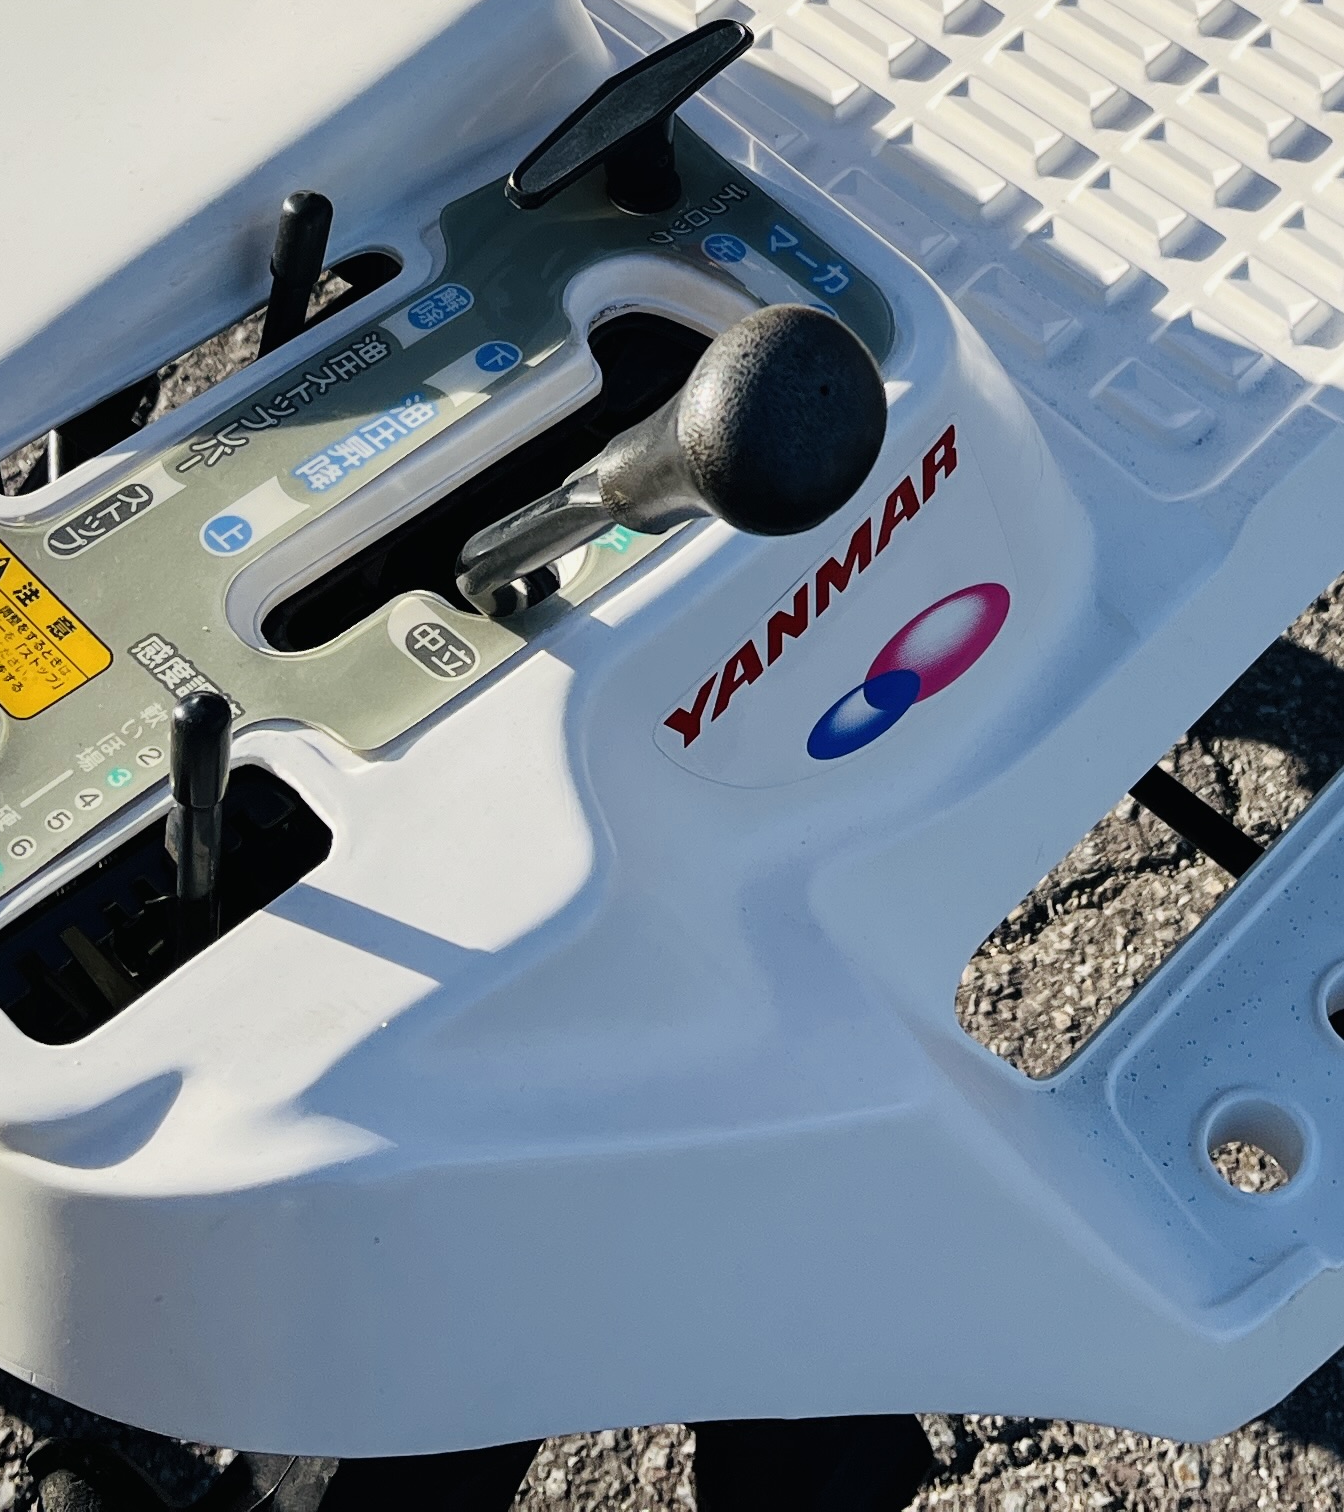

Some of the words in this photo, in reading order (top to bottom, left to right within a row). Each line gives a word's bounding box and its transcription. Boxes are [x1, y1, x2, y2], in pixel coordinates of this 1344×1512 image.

[770, 224, 850, 294] マーカ
[411, 285, 473, 330] 解除
[482, 344, 515, 368] 下
[175, 333, 392, 473] 油圧ストップレバー
[295, 394, 439, 493] 油圧昇降
[57, 486, 150, 551] ストップ
[211, 521, 245, 551] 上
[663, 424, 958, 749] YANMAR
[13, 579, 77, 643] 注意
[412, 624, 473, 677] 中立
[108, 769, 131, 788] 3
[139, 746, 163, 766] 2
[47, 810, 72, 832] 5
[78, 790, 101, 810] 4
[10, 836, 35, 858] 6
